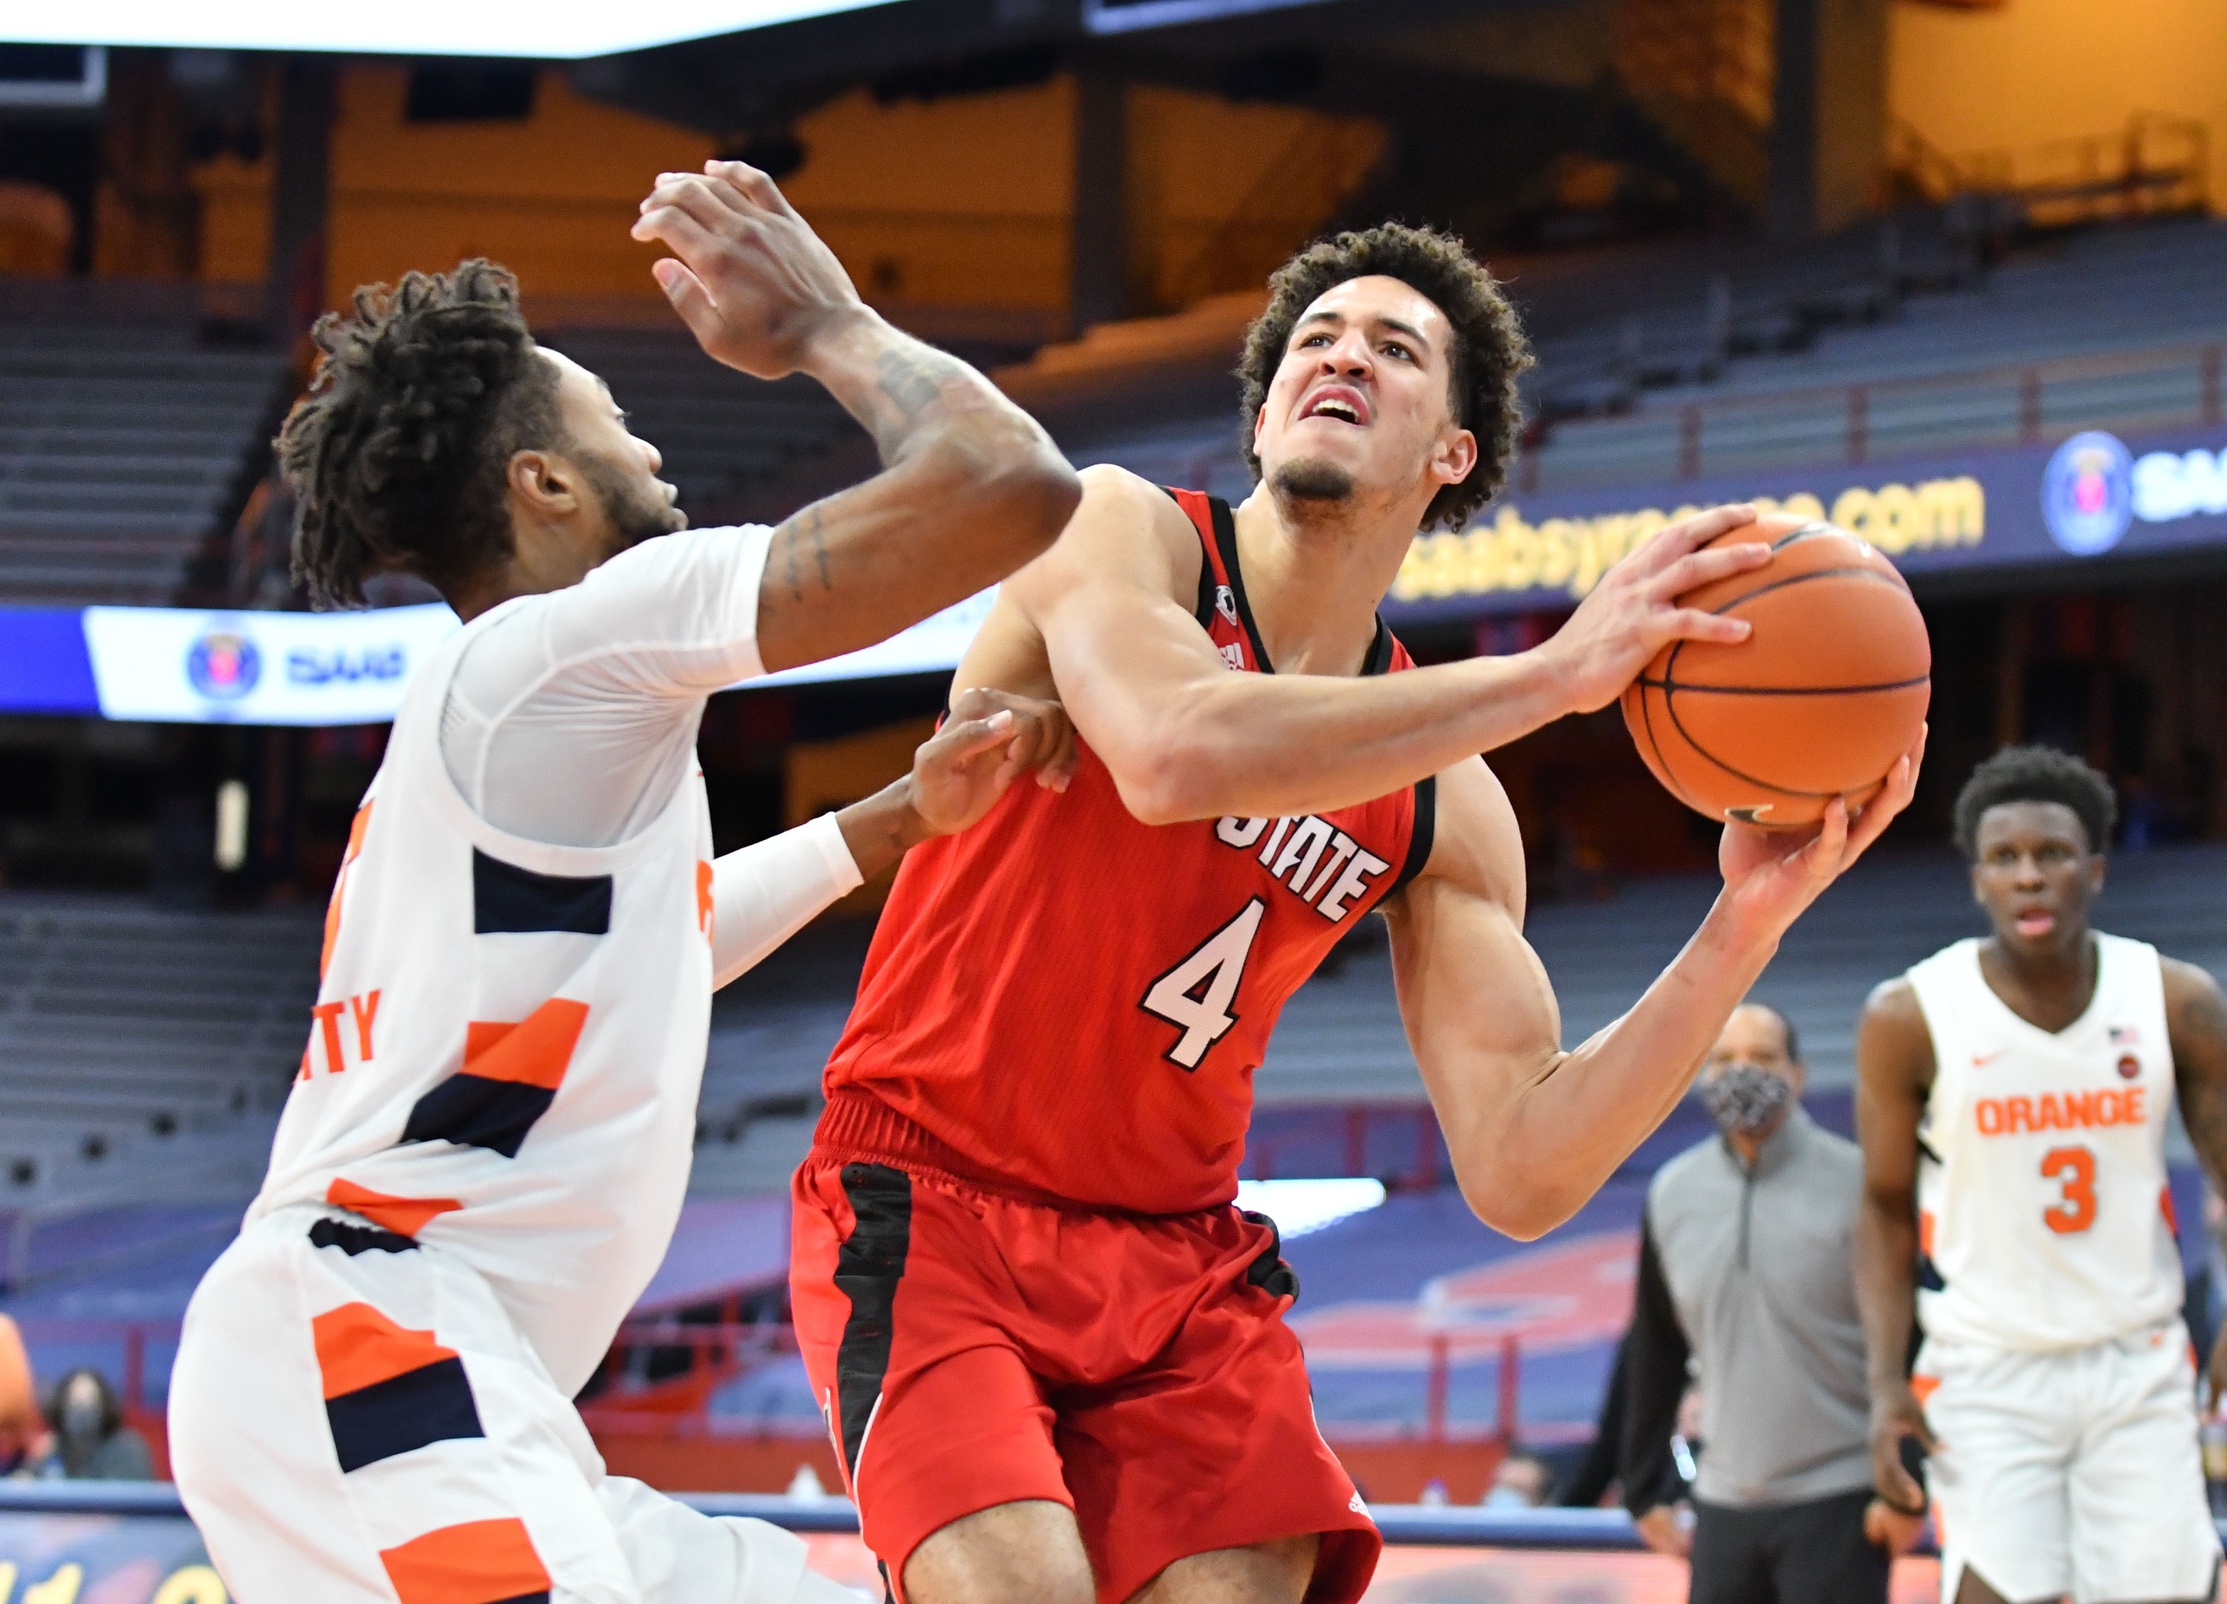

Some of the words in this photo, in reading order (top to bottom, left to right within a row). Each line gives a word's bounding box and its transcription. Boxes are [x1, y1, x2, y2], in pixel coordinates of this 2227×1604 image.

[1139, 894, 1266, 1073] 4
[1975, 1086, 2147, 1136] ORANGE
[2040, 1145, 2098, 1235] 3
